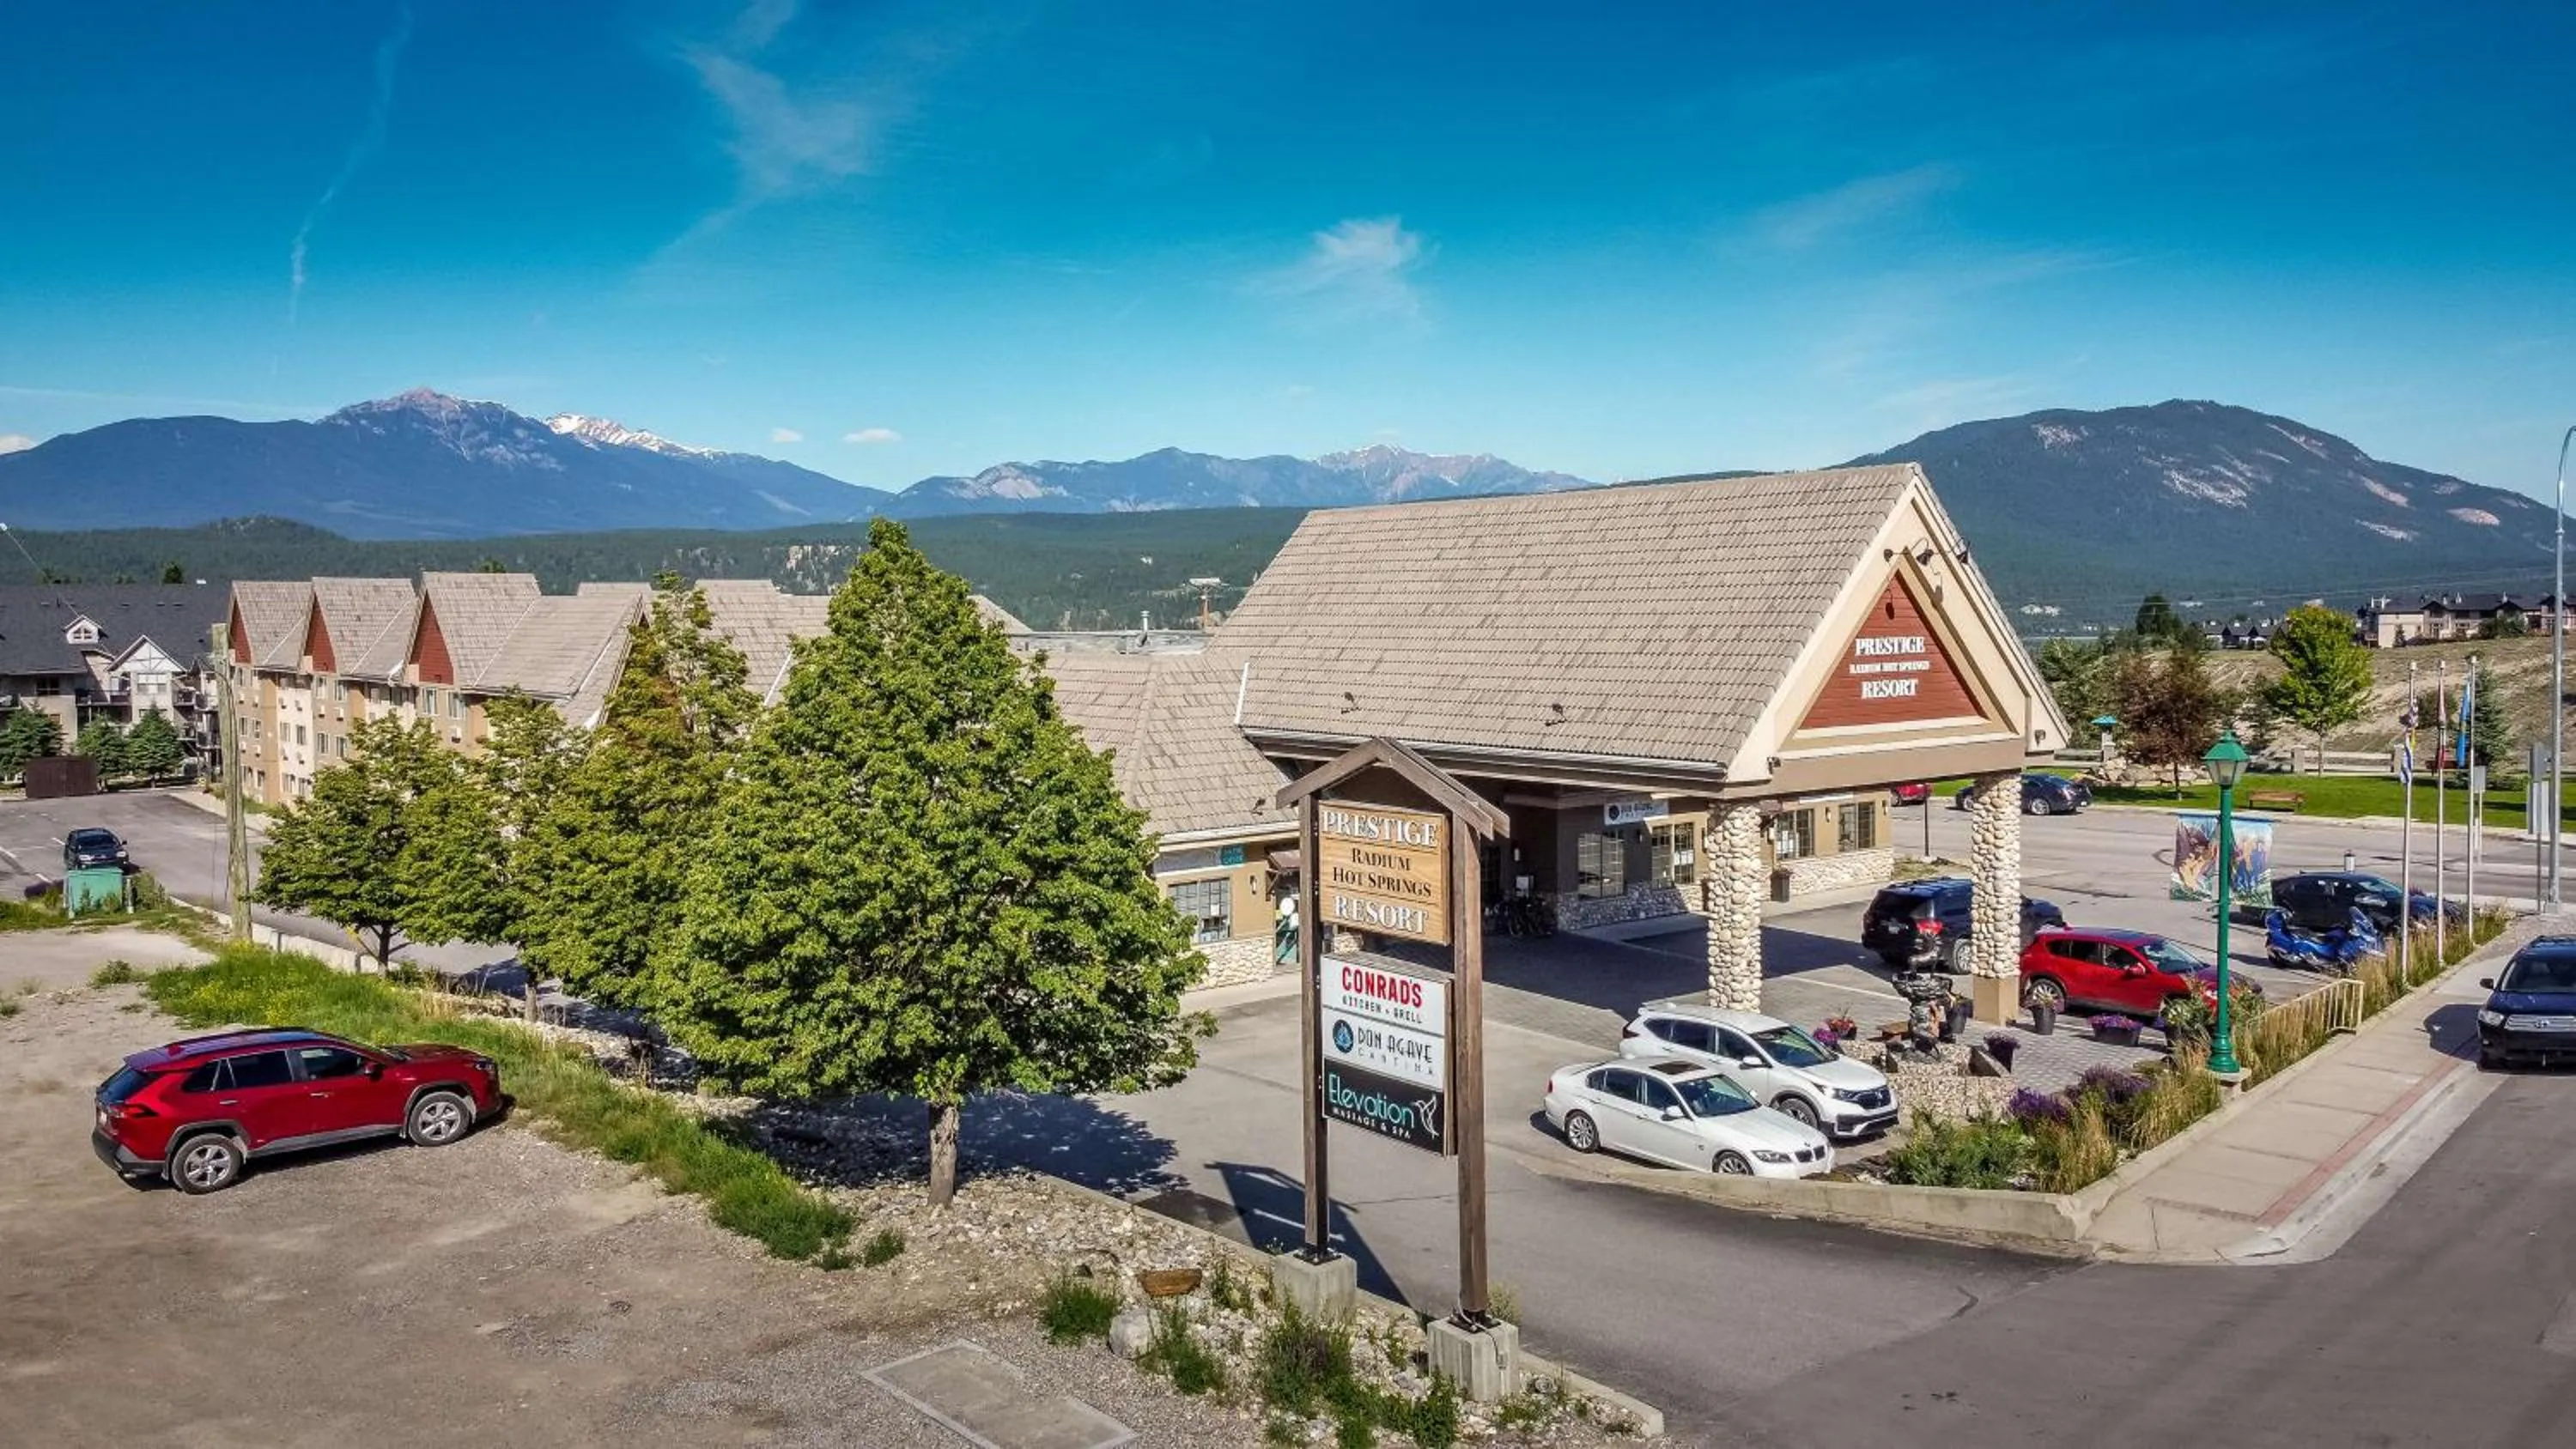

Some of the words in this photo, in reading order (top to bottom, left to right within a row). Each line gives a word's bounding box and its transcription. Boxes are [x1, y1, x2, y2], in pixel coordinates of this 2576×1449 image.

[1855, 636, 1925, 657] PRESTIGE
[1861, 678, 1918, 699] RESORT
[1321, 809, 1438, 847] PRESTIGE
[1352, 847, 1411, 871] RADIUM
[1333, 867, 1364, 885] HOT
[1368, 870, 1431, 897] SPRINGS
[1334, 894, 1429, 934] RESORT
[1342, 967, 1422, 1008] CONRAD'S
[1342, 995, 1381, 1013] KITCHEN
[1394, 1008, 1422, 1024] GRILL
[1358, 1026, 1382, 1050] DON
[1388, 1034, 1432, 1063] AGAVE
[1328, 1073, 1415, 1129] Elevation
[1392, 1125, 1411, 1139] SPA
